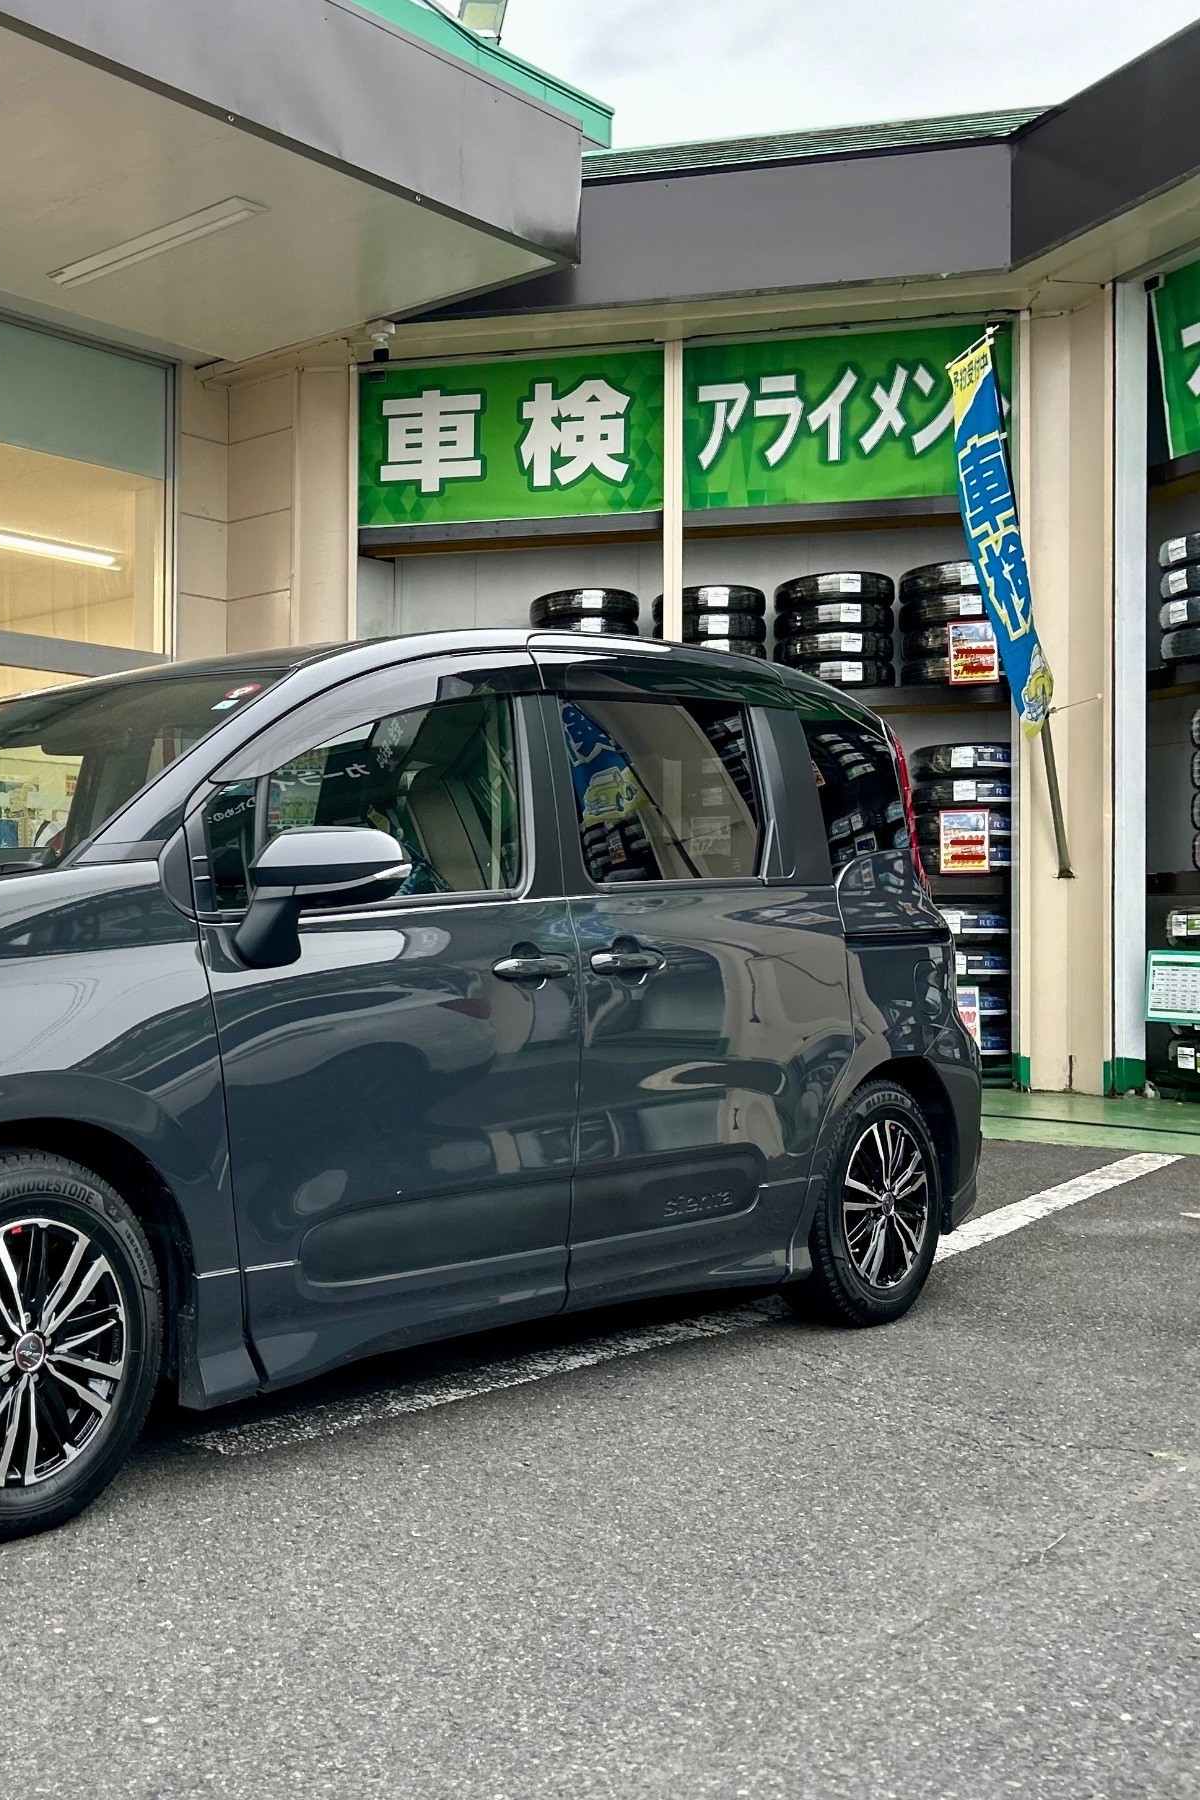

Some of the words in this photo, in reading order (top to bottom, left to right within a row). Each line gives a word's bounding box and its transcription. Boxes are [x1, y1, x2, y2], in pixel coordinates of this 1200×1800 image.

[380, 379, 631, 493] 車検
[698, 363, 1010, 471] アライメン
[0, 1178, 96, 1206] BRIDGESTONE
